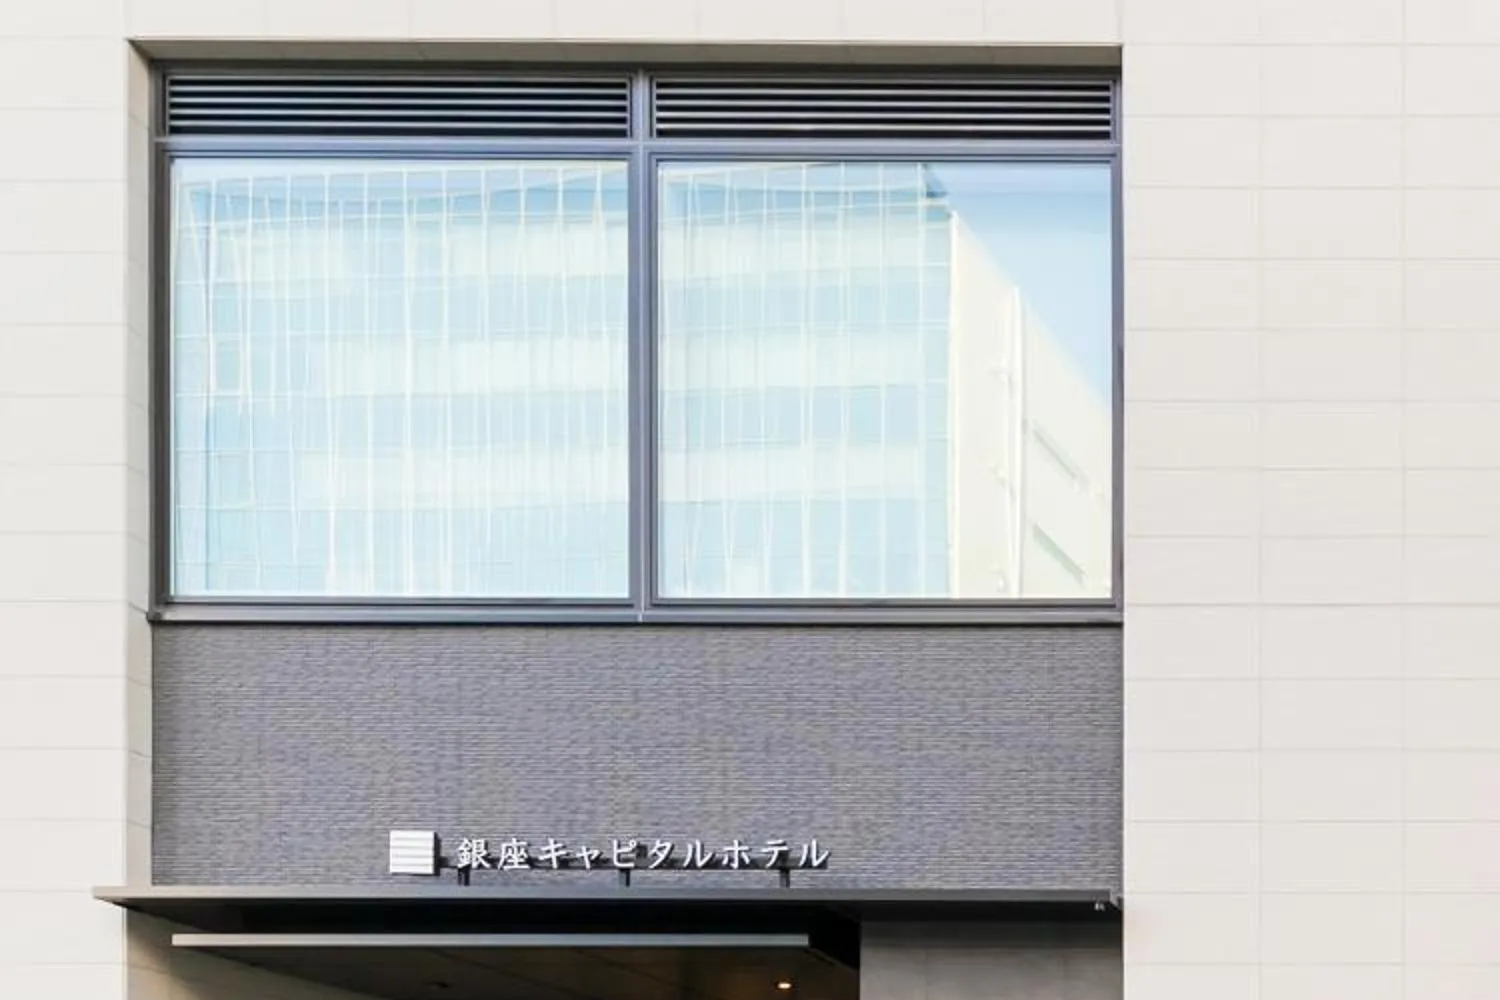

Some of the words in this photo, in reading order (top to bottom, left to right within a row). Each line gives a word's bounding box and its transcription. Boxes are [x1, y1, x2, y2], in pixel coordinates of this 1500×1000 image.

[457, 838, 829, 869] 銀座キャピタルホテル
